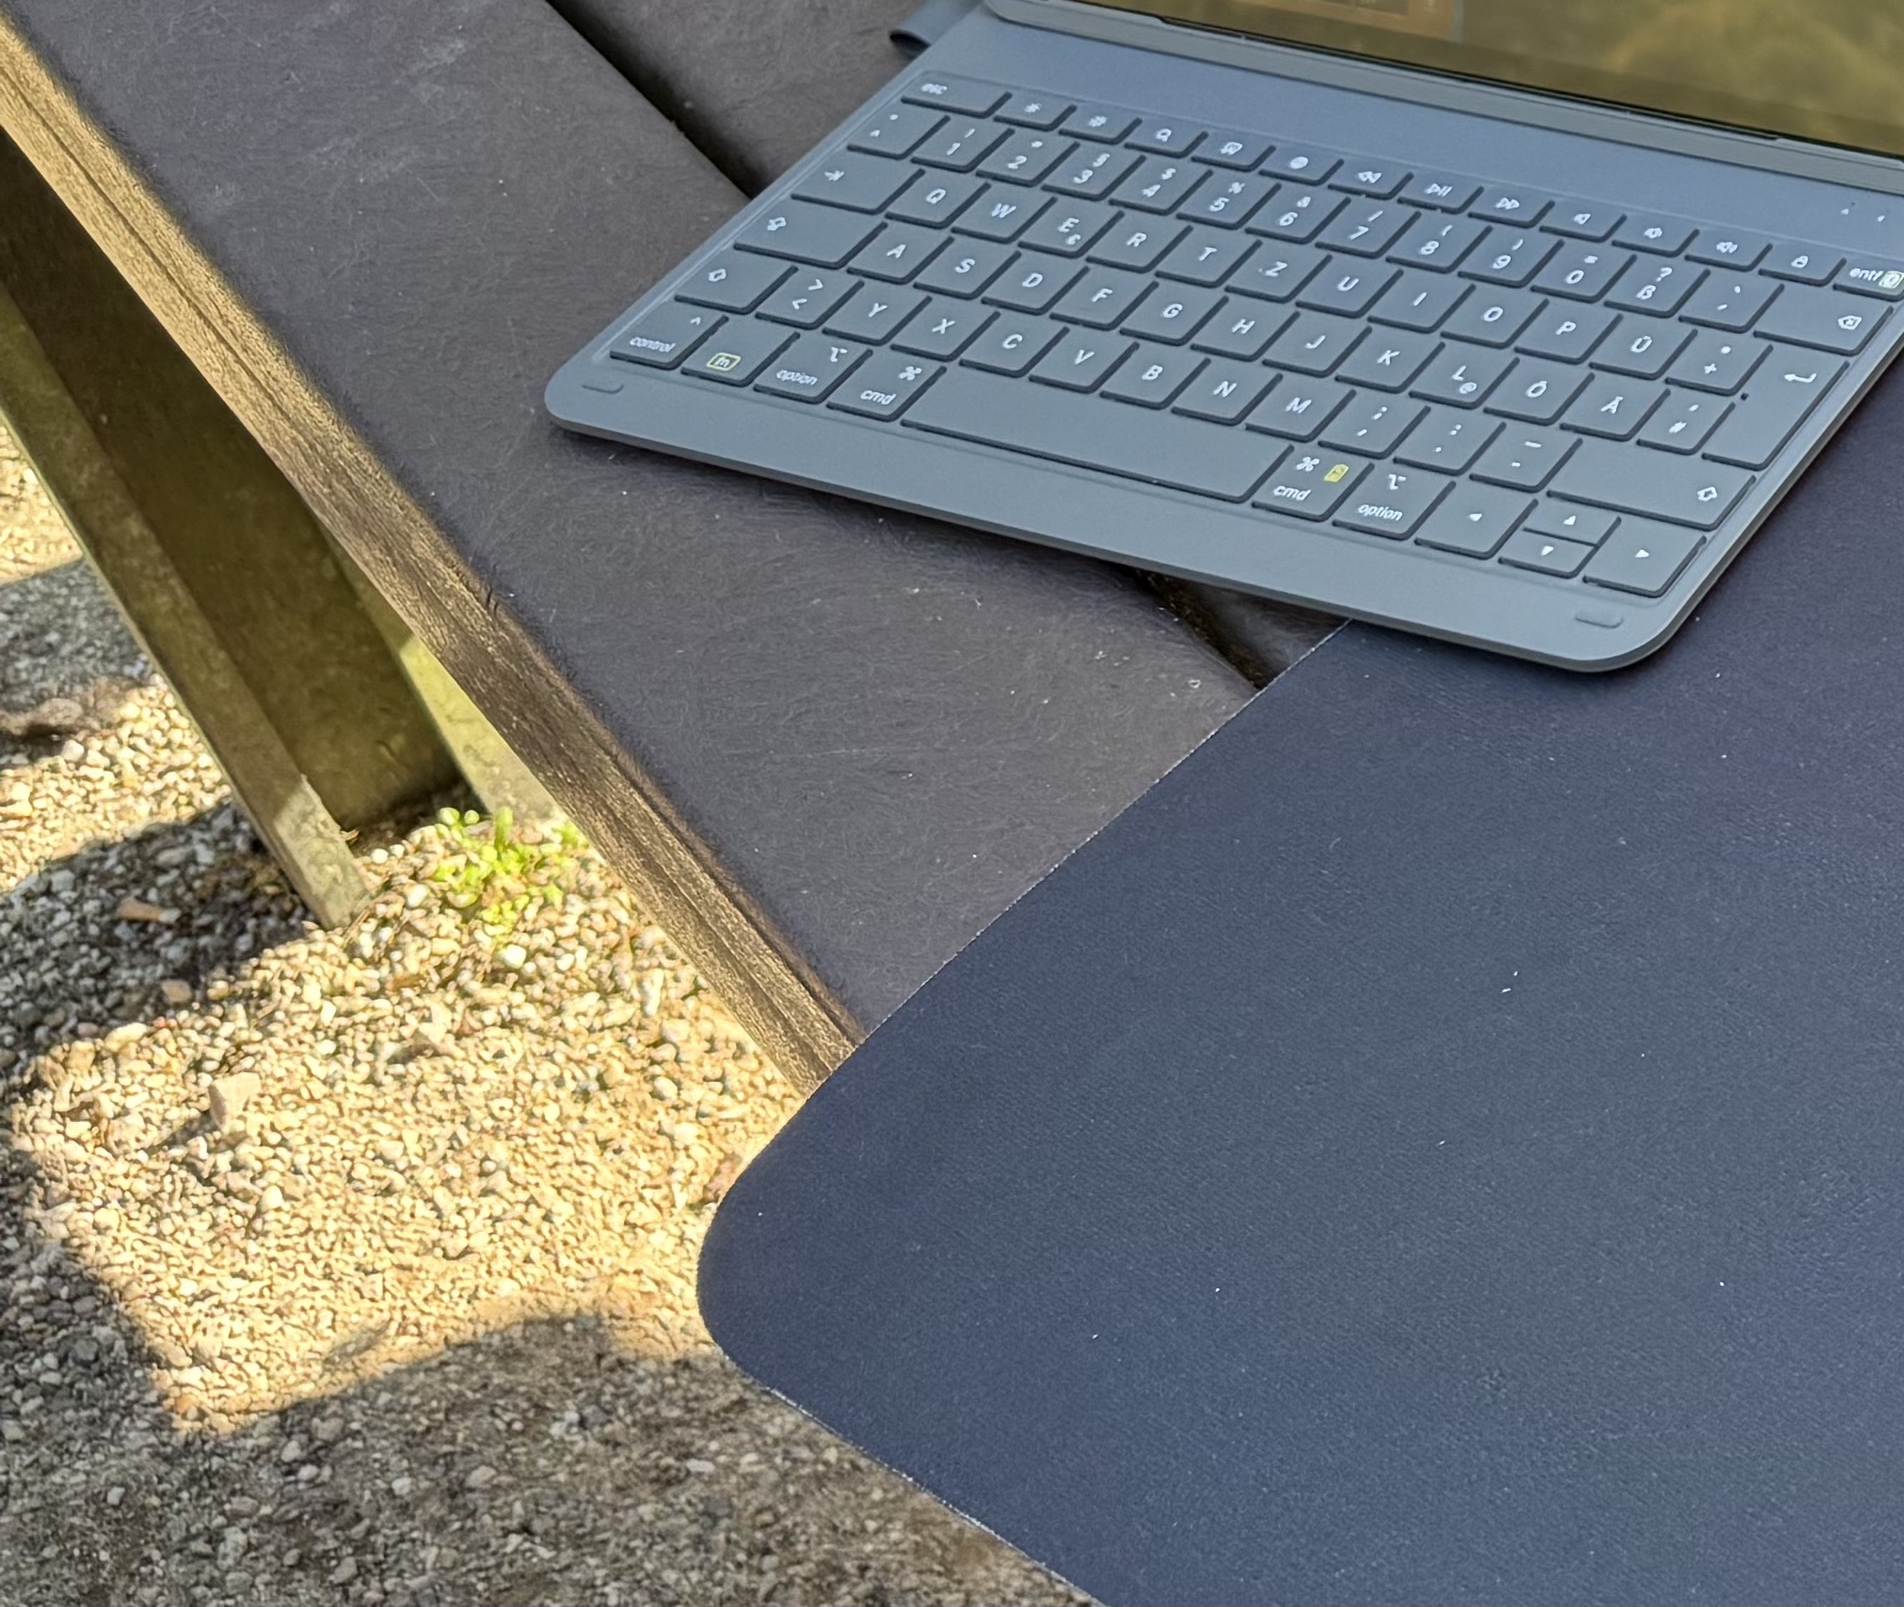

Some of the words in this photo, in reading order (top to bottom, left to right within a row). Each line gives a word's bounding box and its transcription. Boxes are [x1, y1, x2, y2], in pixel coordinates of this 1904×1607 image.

[1007, 155, 1028, 170] 2
[1073, 169, 1094, 184] 3
[925, 188, 947, 205] Q
[1141, 184, 1161, 198] 4
[990, 202, 1017, 219] W
[1208, 196, 1230, 212] 5
[1057, 217, 1080, 233] E
[1278, 211, 1299, 227] 6
[1125, 232, 1147, 248] R
[1348, 225, 1370, 240] 7
[886, 244, 907, 259] A
[1198, 246, 1218, 262] T
[1418, 240, 1440, 256] 8
[954, 258, 976, 274] S
[1264, 261, 1288, 277] Z
[1491, 254, 1512, 270] 9
[1021, 272, 1044, 288] D
[1336, 276, 1360, 292] U
[1091, 288, 1113, 303] F
[868, 302, 888, 318] Y
[1162, 303, 1183, 319] G
[931, 318, 956, 335] X
[1231, 318, 1256, 335] H
[1555, 320, 1577, 336] P
[628, 336, 677, 353] control
[1001, 333, 1023, 350] C
[1304, 334, 1326, 350] J
[1074, 349, 1095, 365] V
[1376, 349, 1401, 366] K
[775, 369, 818, 386] option
[1141, 364, 1164, 381] B
[1450, 365, 1467, 381] L
[860, 389, 897, 405] cmd
[1212, 380, 1238, 398] N
[1284, 397, 1312, 414] M
[1272, 485, 1312, 501] cmd
[1357, 504, 1403, 522] option
